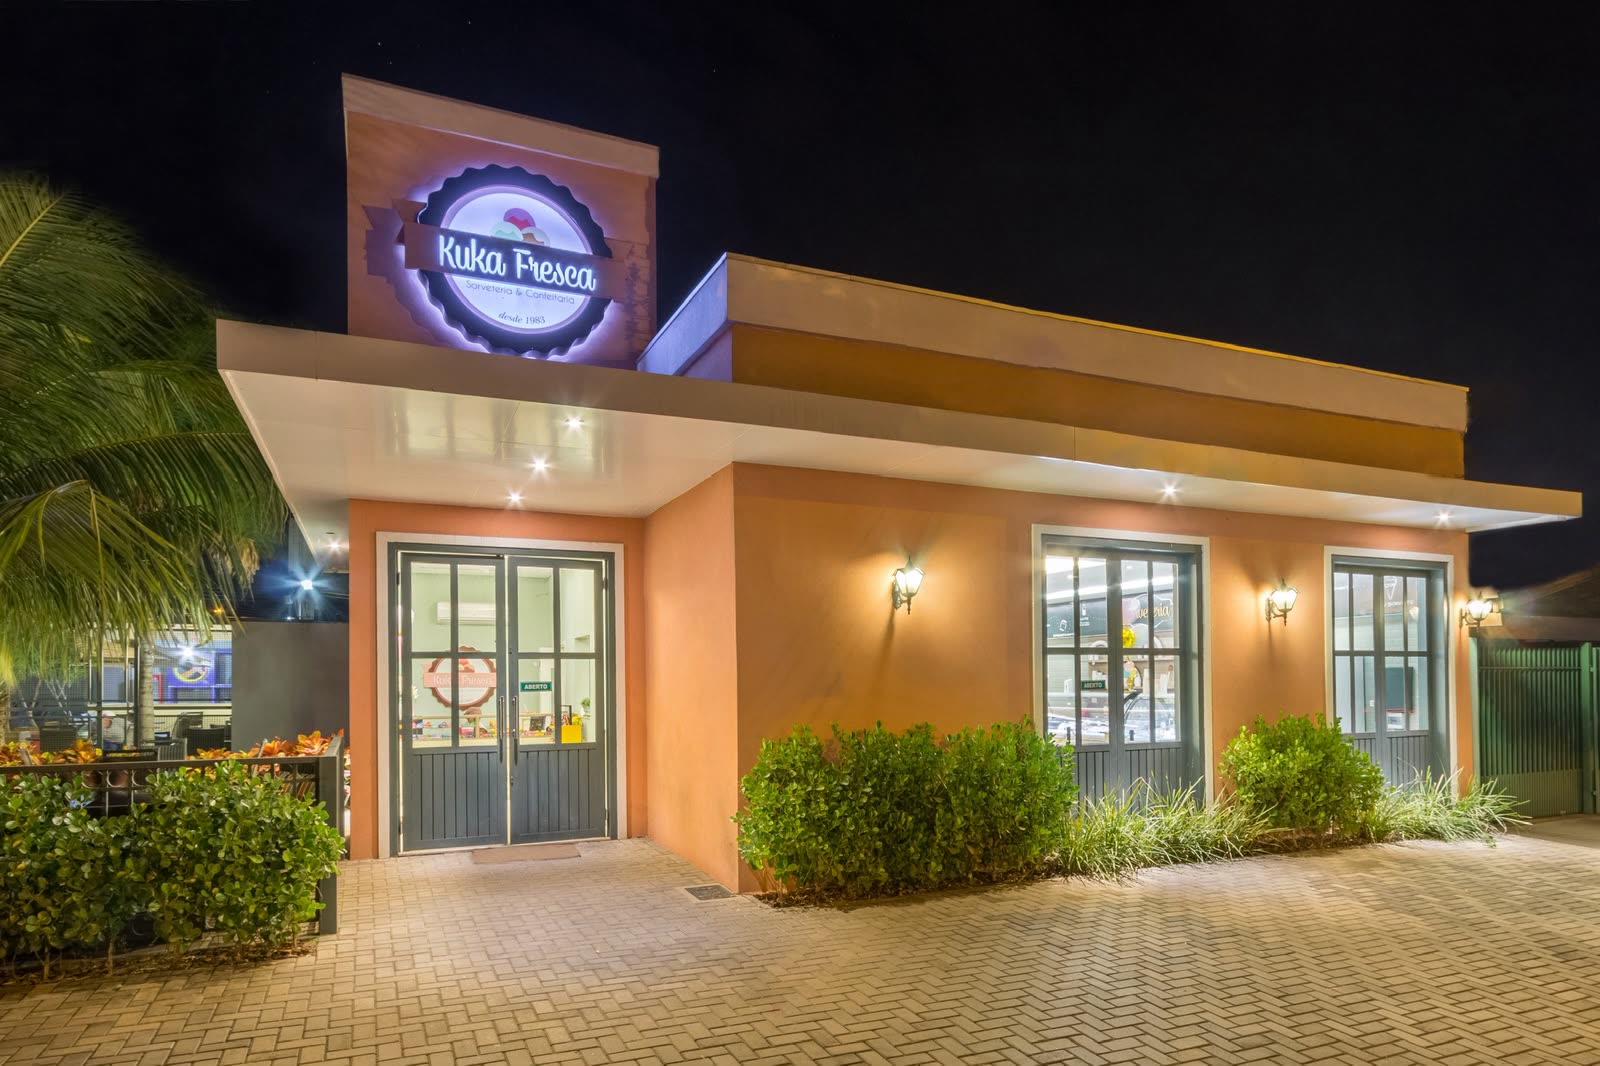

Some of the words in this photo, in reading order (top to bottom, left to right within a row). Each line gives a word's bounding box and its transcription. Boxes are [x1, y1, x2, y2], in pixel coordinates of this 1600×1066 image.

[438, 234, 507, 277] Kuka
[512, 247, 597, 292] Fresca
[465, 279, 513, 295] Sorveteria
[515, 287, 523, 296] &
[525, 288, 575, 305] Confeitaria
[498, 311, 523, 324] desde
[525, 315, 546, 325] 1983
